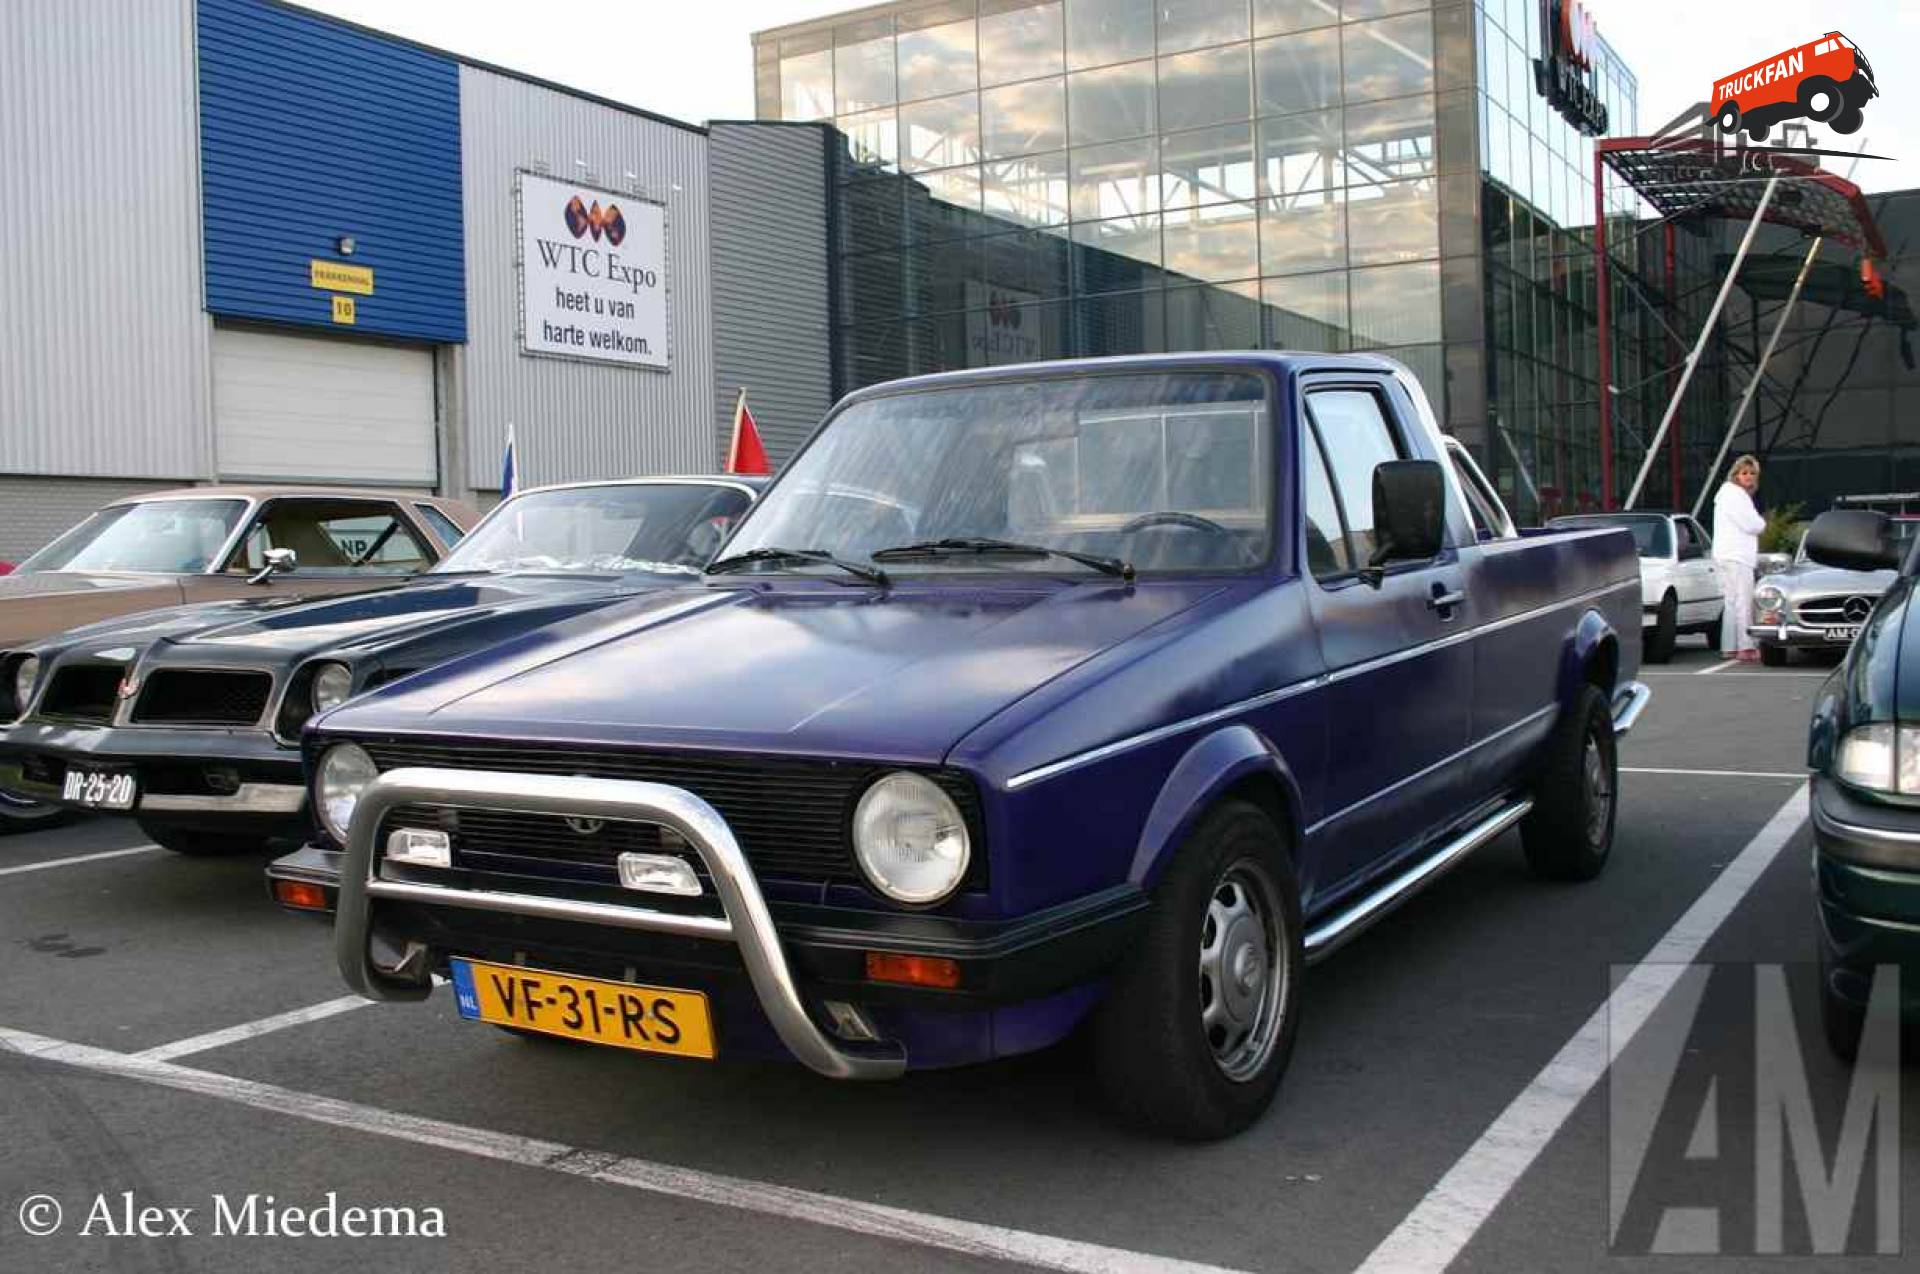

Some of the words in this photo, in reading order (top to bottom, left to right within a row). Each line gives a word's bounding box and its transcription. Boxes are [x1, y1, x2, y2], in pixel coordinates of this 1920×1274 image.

[537, 239, 600, 278] WTC
[607, 253, 657, 294] Expo
[556, 286, 591, 313] heet
[594, 298, 604, 315] u
[608, 299, 635, 319] van
[543, 319, 585, 346] harte
[589, 325, 653, 355] welkom.
[491, 974, 681, 1045] VF-31-RS
